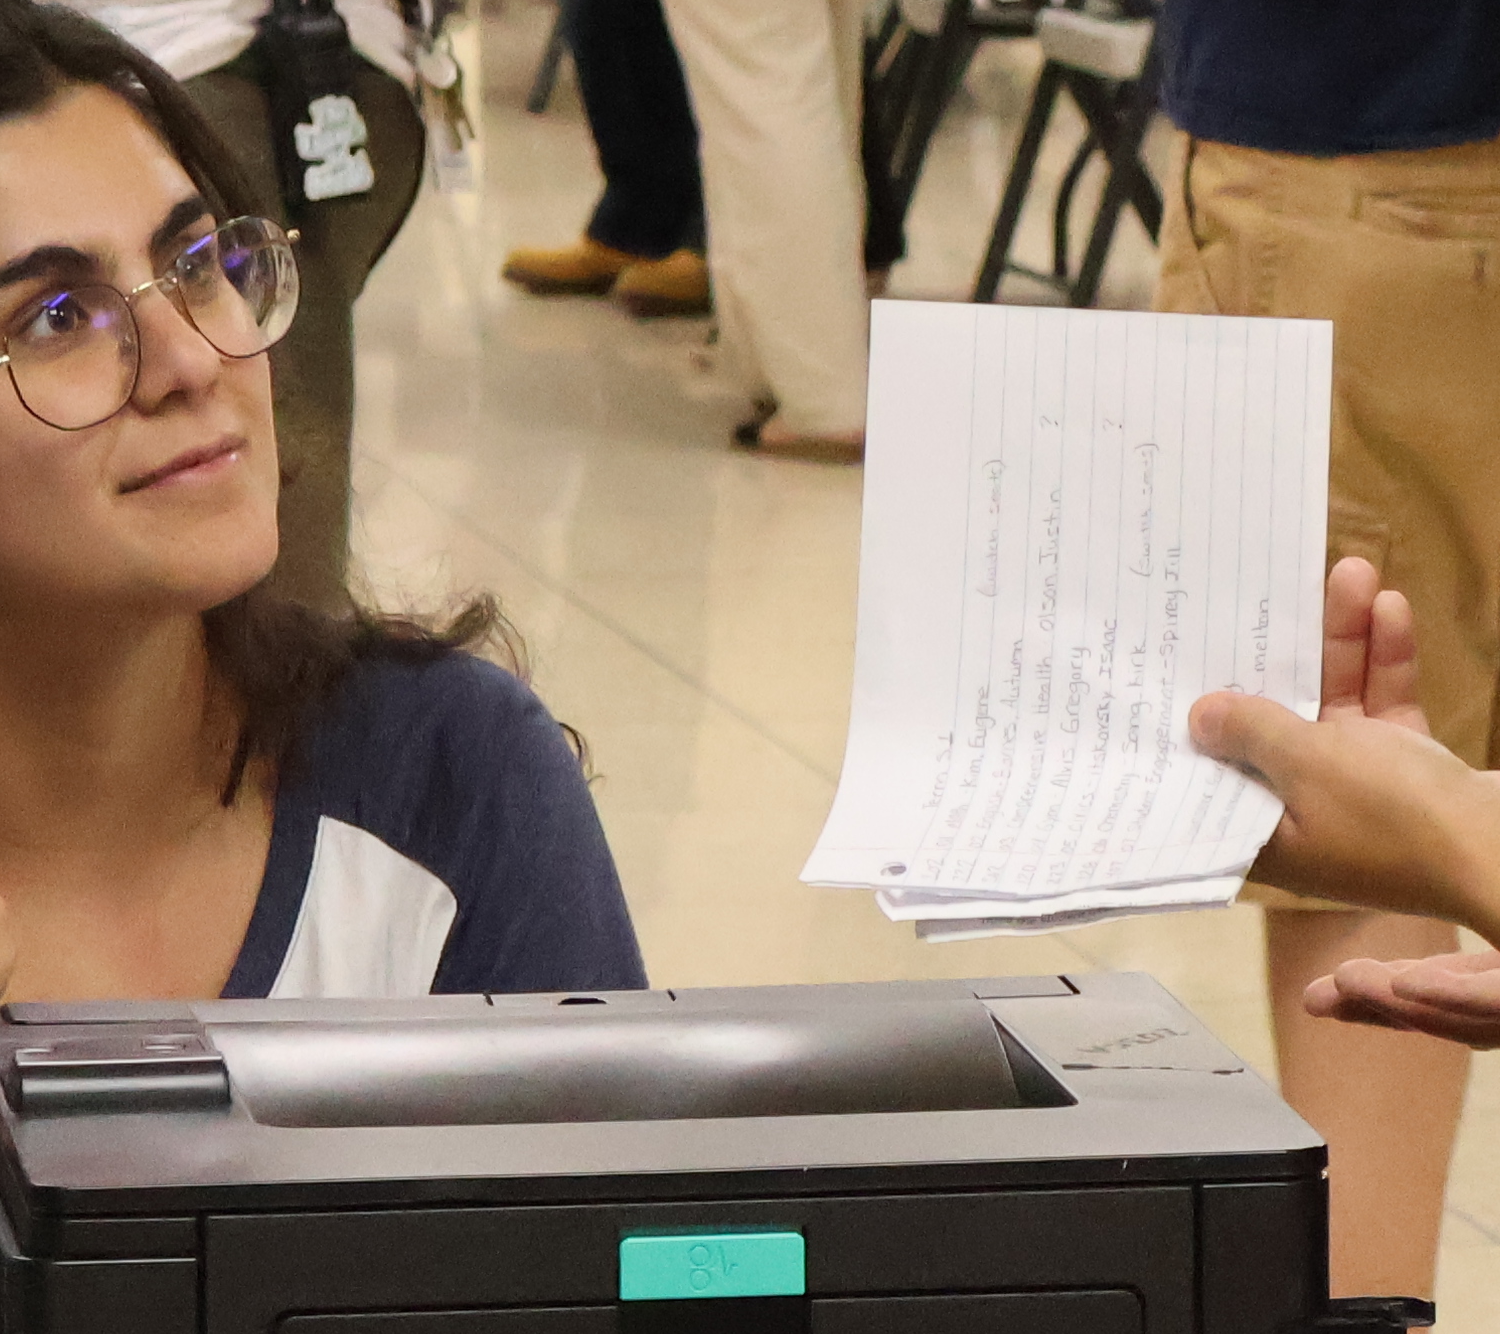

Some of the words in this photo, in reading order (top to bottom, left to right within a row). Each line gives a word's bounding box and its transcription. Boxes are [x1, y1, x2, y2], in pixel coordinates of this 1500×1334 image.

[999, 638, 1024, 709] Autumn
[1059, 646, 1091, 734] Gregory
[967, 684, 997, 748] Eugene
